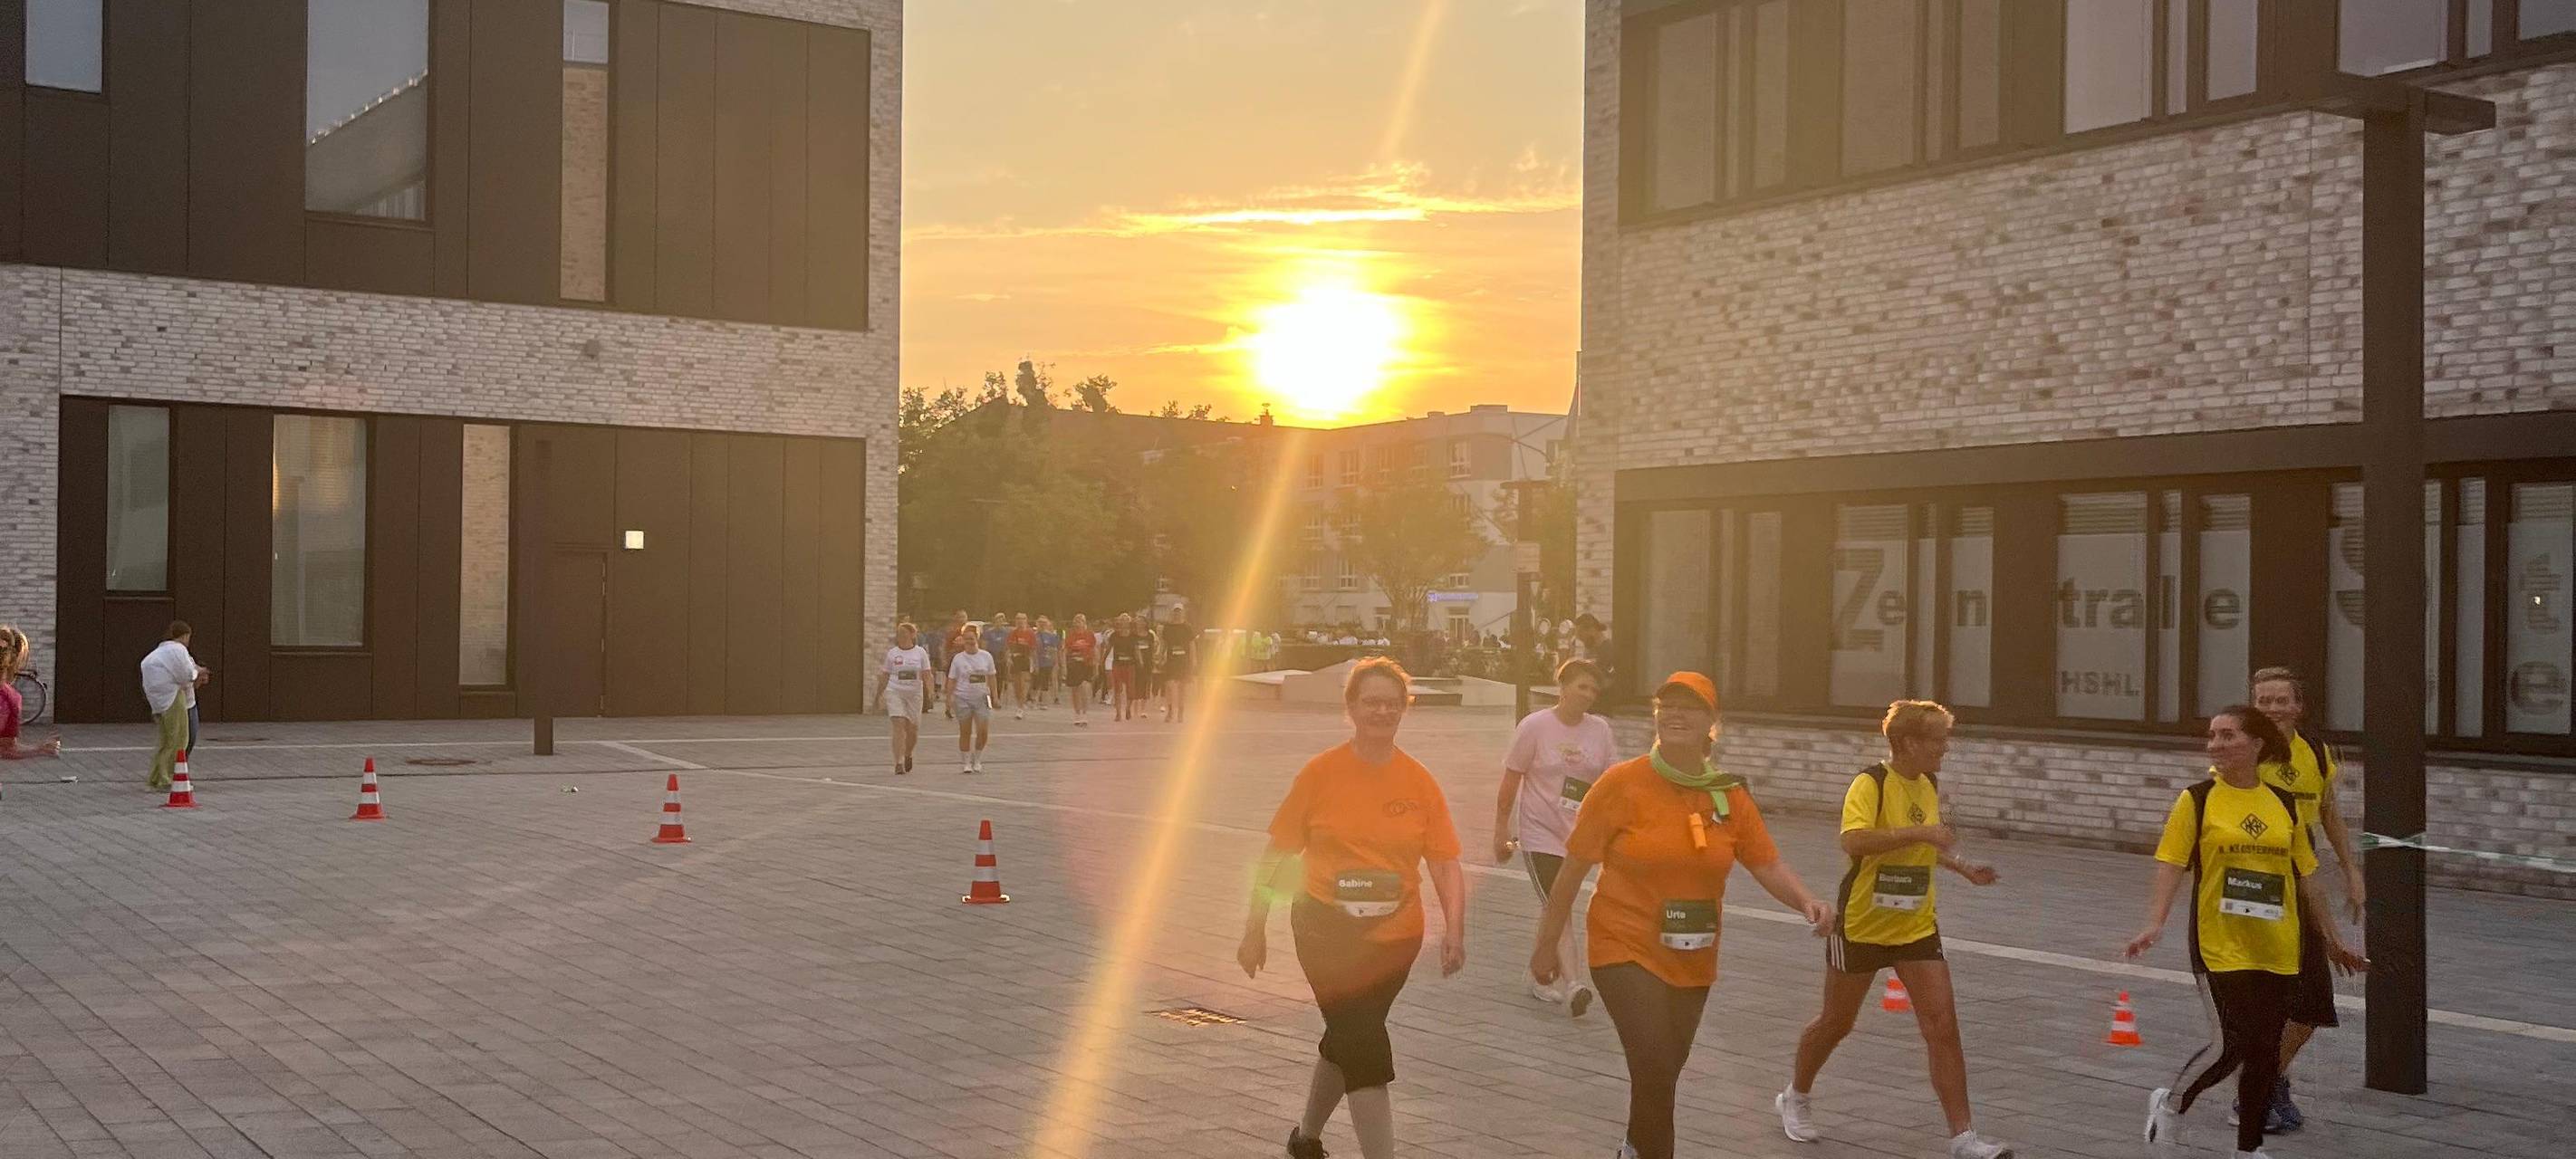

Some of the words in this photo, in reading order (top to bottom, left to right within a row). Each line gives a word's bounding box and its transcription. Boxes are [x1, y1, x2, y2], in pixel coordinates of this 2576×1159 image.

[2060, 670, 2140, 696] HSHL
[1338, 878, 1373, 888] Sabine
[2227, 876, 2263, 890] Markus
